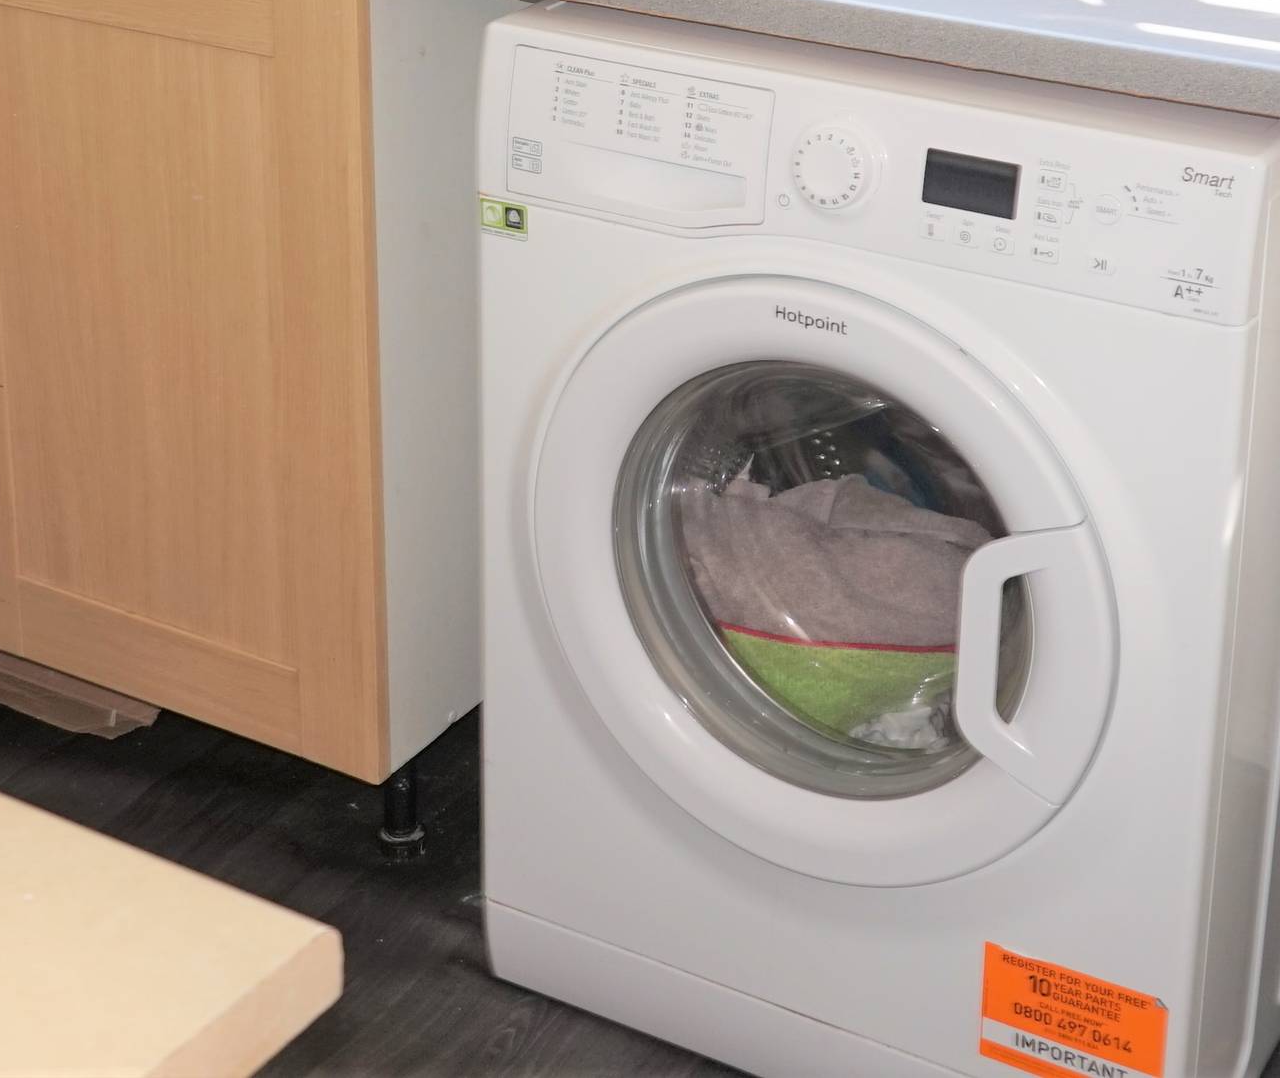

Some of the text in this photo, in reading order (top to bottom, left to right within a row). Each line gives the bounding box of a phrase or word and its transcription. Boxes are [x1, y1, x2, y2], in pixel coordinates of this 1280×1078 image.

[1182, 166, 1234, 189] Smart
[1173, 284, 1204, 300] A++
[775, 304, 848, 336] Hotpoint
[1002, 953, 1057, 979] REGISTER
[1059, 972, 1081, 988] FOR
[1084, 982, 1115, 1000] YOUR
[1028, 974, 1121, 1012] 10 YEAR PARTS
[1039, 1002, 1059, 1014] CALL
[1052, 992, 1121, 1023] GUARANTEE
[1013, 1001, 1053, 1025] 0800
[1056, 1018, 1088, 1037] 497
[1091, 1028, 1133, 1054] 0614
[1014, 1032, 1129, 1078] IMPORTANT
